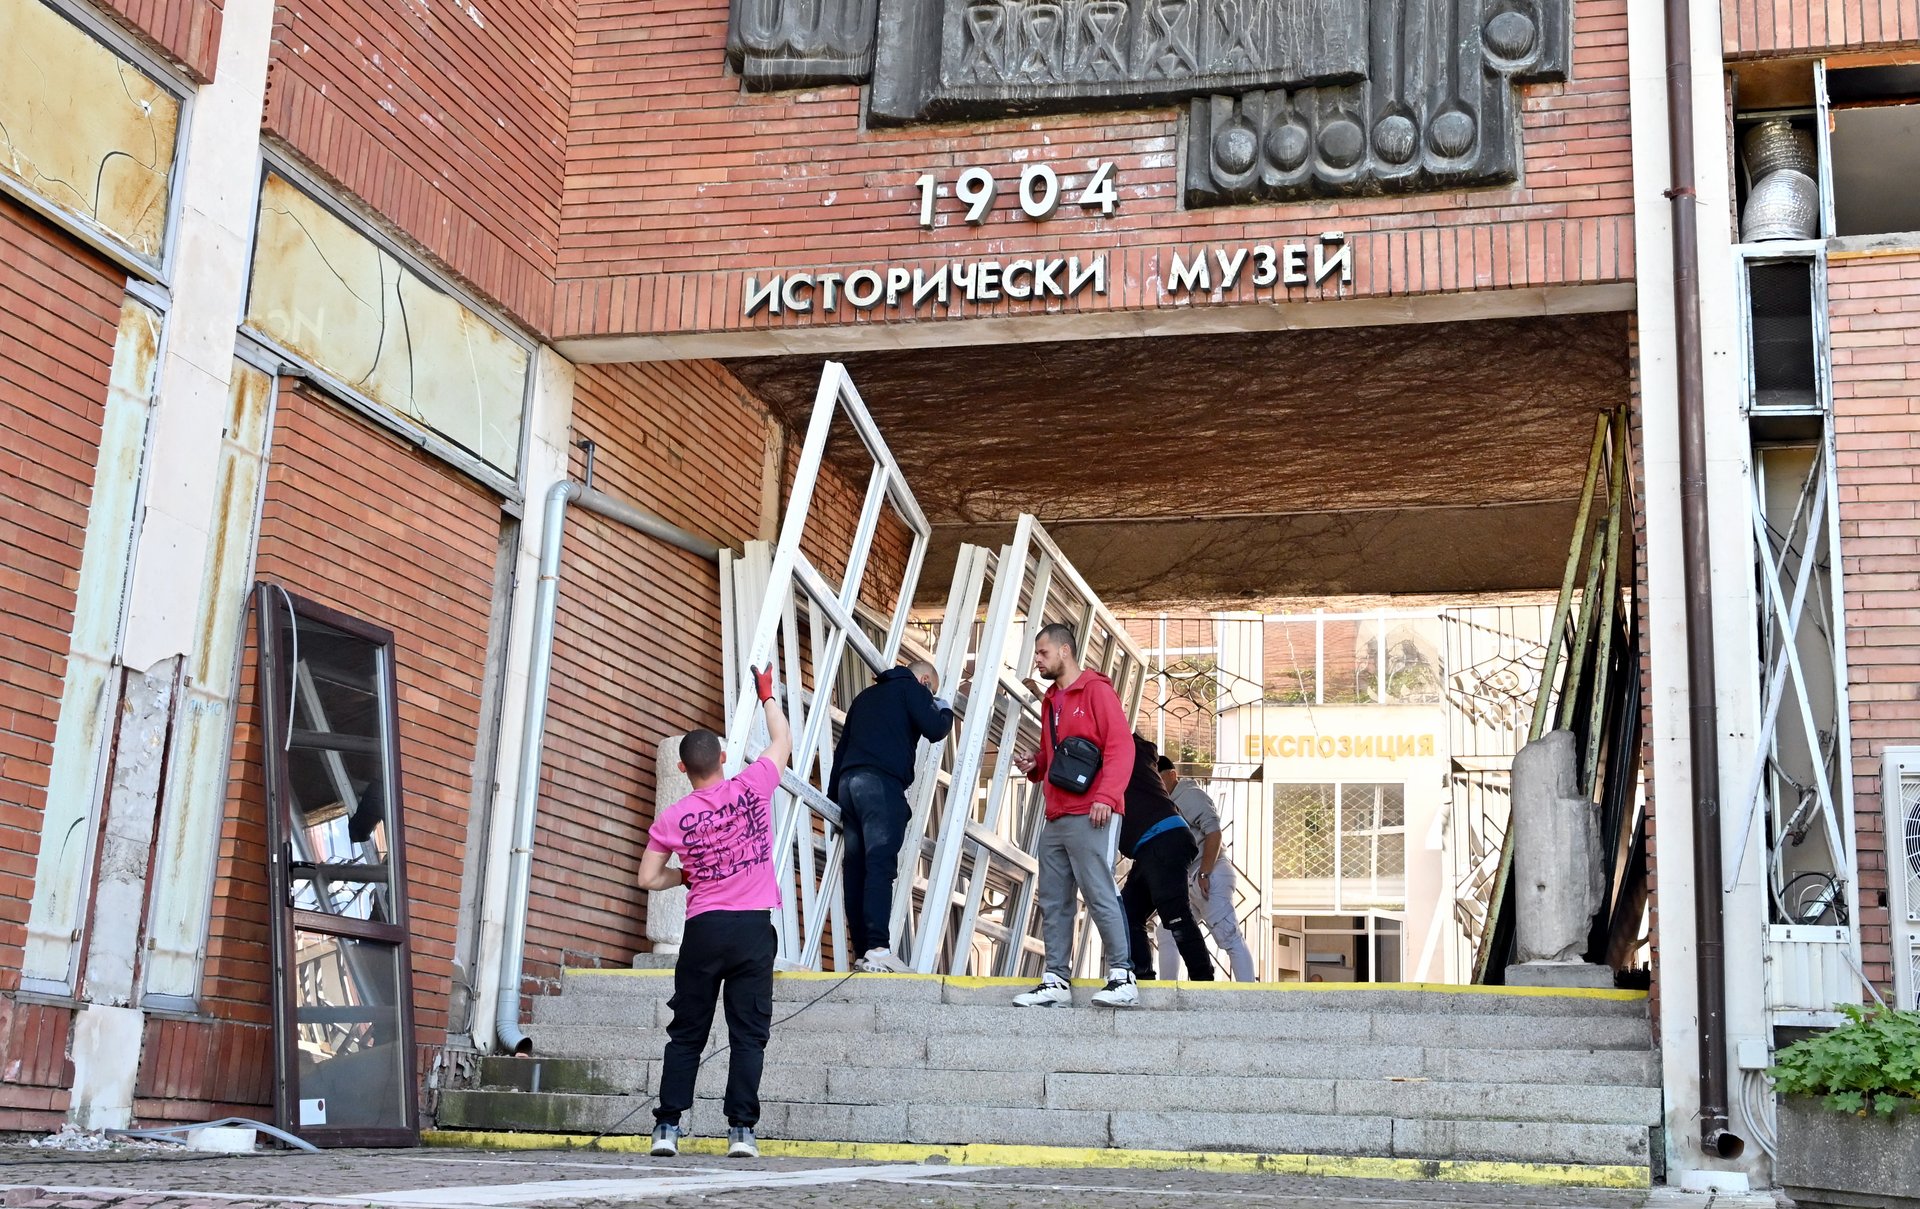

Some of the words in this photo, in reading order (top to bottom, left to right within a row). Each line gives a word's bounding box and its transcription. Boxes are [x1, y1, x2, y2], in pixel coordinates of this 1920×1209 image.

[914, 162, 1120, 230] 1904
[743, 252, 1107, 318] ИСТОРИЧЕСКИ
[1166, 231, 1353, 295] МУЗЕЙ
[1244, 733, 1435, 762] ЕКСПОЗИЦИЯ
